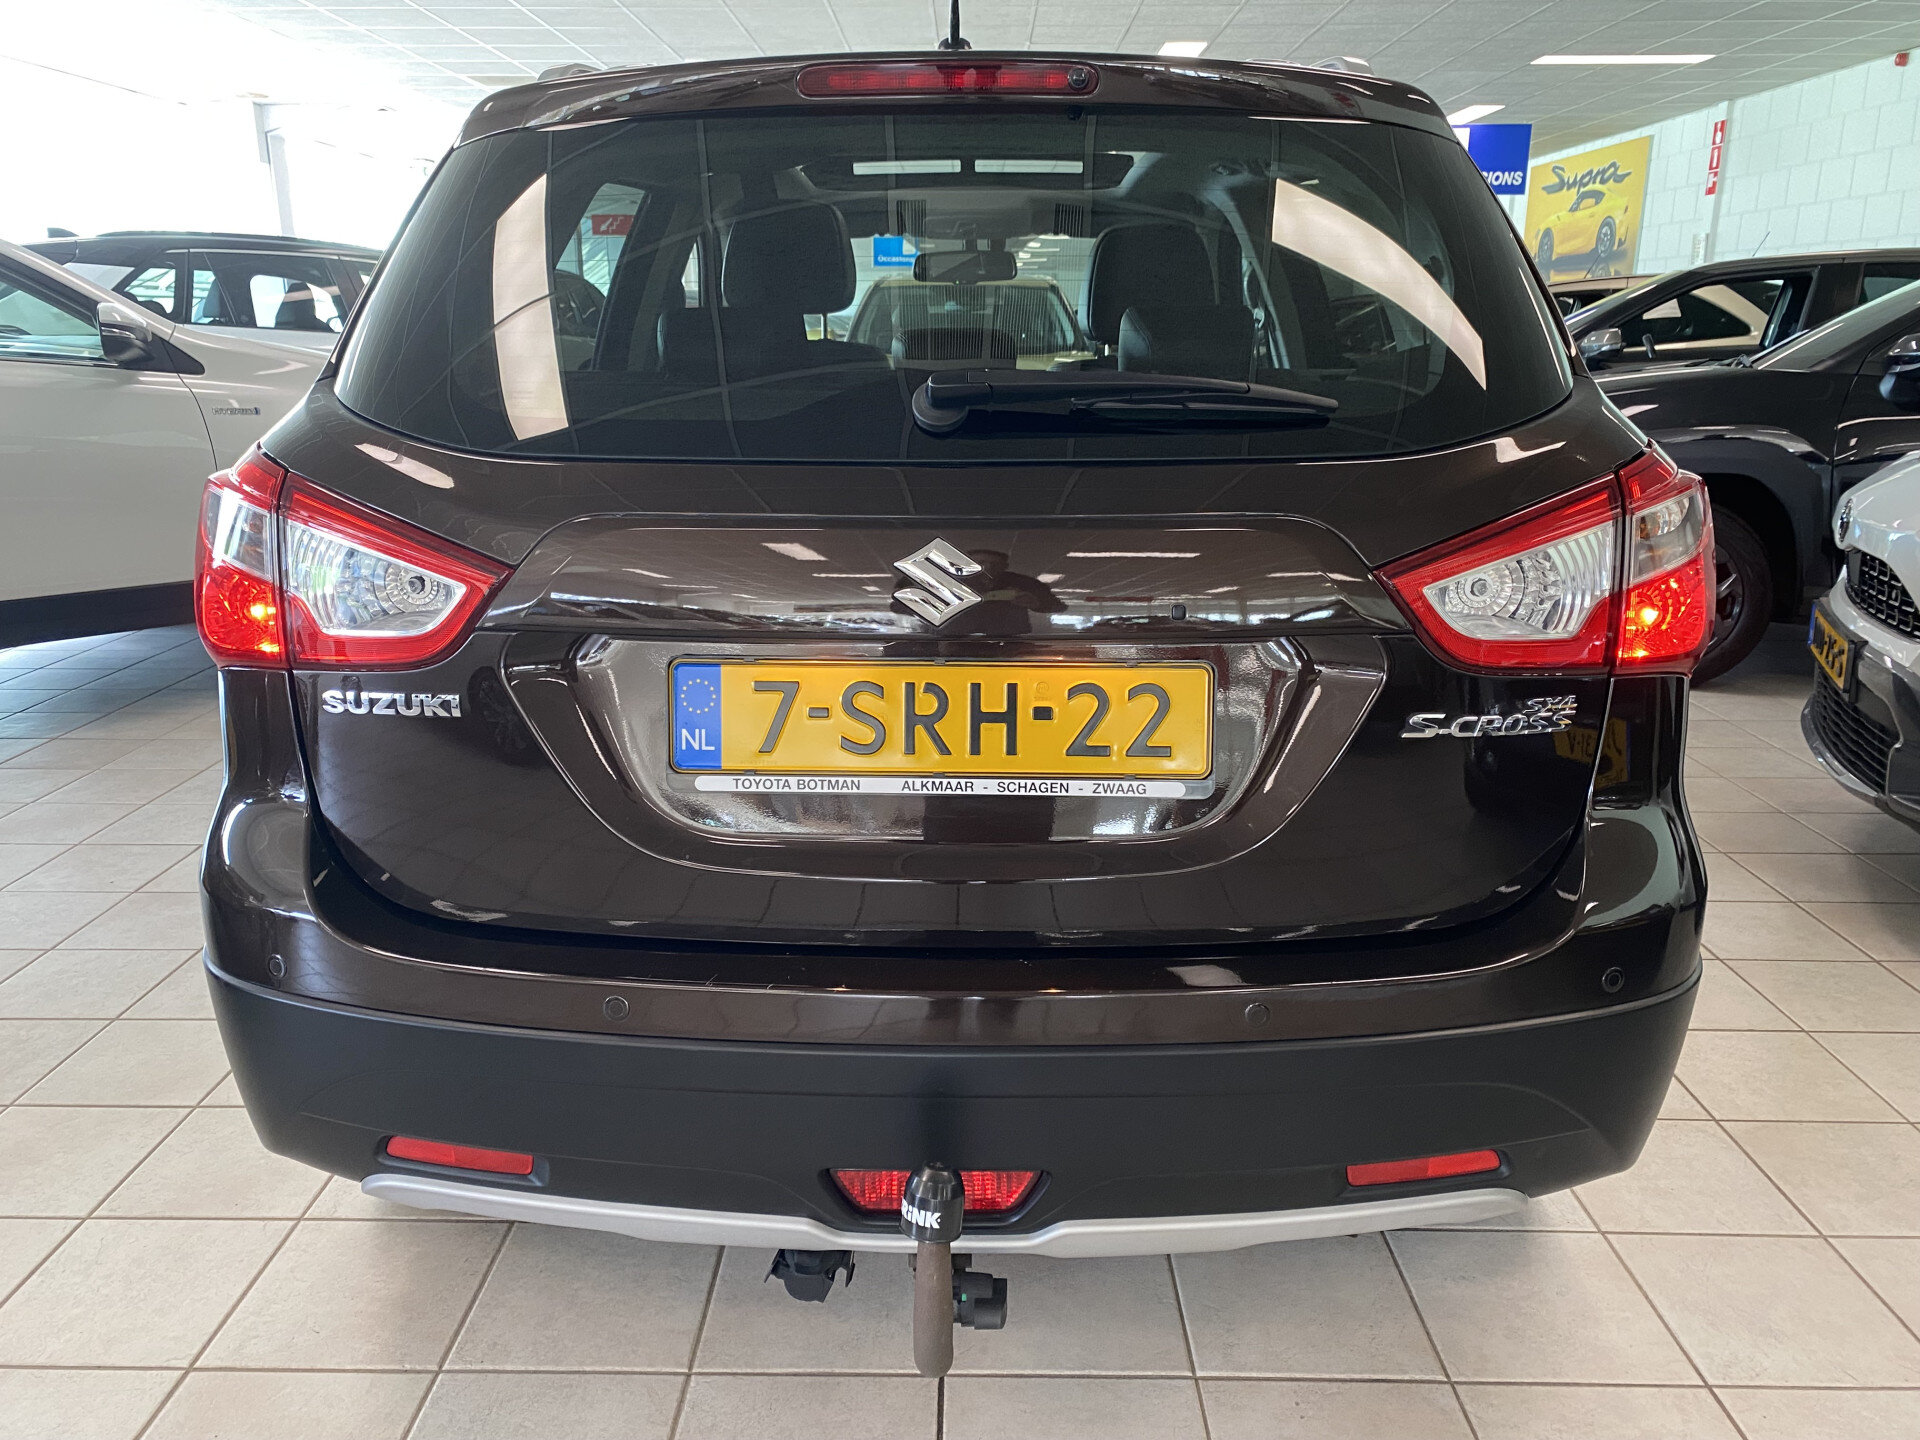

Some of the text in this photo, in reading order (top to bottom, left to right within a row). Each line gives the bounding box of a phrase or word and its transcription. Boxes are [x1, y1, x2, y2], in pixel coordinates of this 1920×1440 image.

[1541, 161, 1632, 195] Supra
[321, 689, 462, 718] SUZUKI
[1523, 695, 1578, 713] SX4
[752, 680, 1172, 758] 7-SRH-22
[1401, 711, 1577, 739] S-CROSS
[681, 728, 716, 751] NL
[732, 778, 792, 790] TOYOTA
[796, 779, 861, 791] BOTMAN
[901, 780, 974, 793] ALKMAAR
[997, 781, 1069, 794] SCHAGEN
[1092, 783, 1147, 795] ZWAAG
